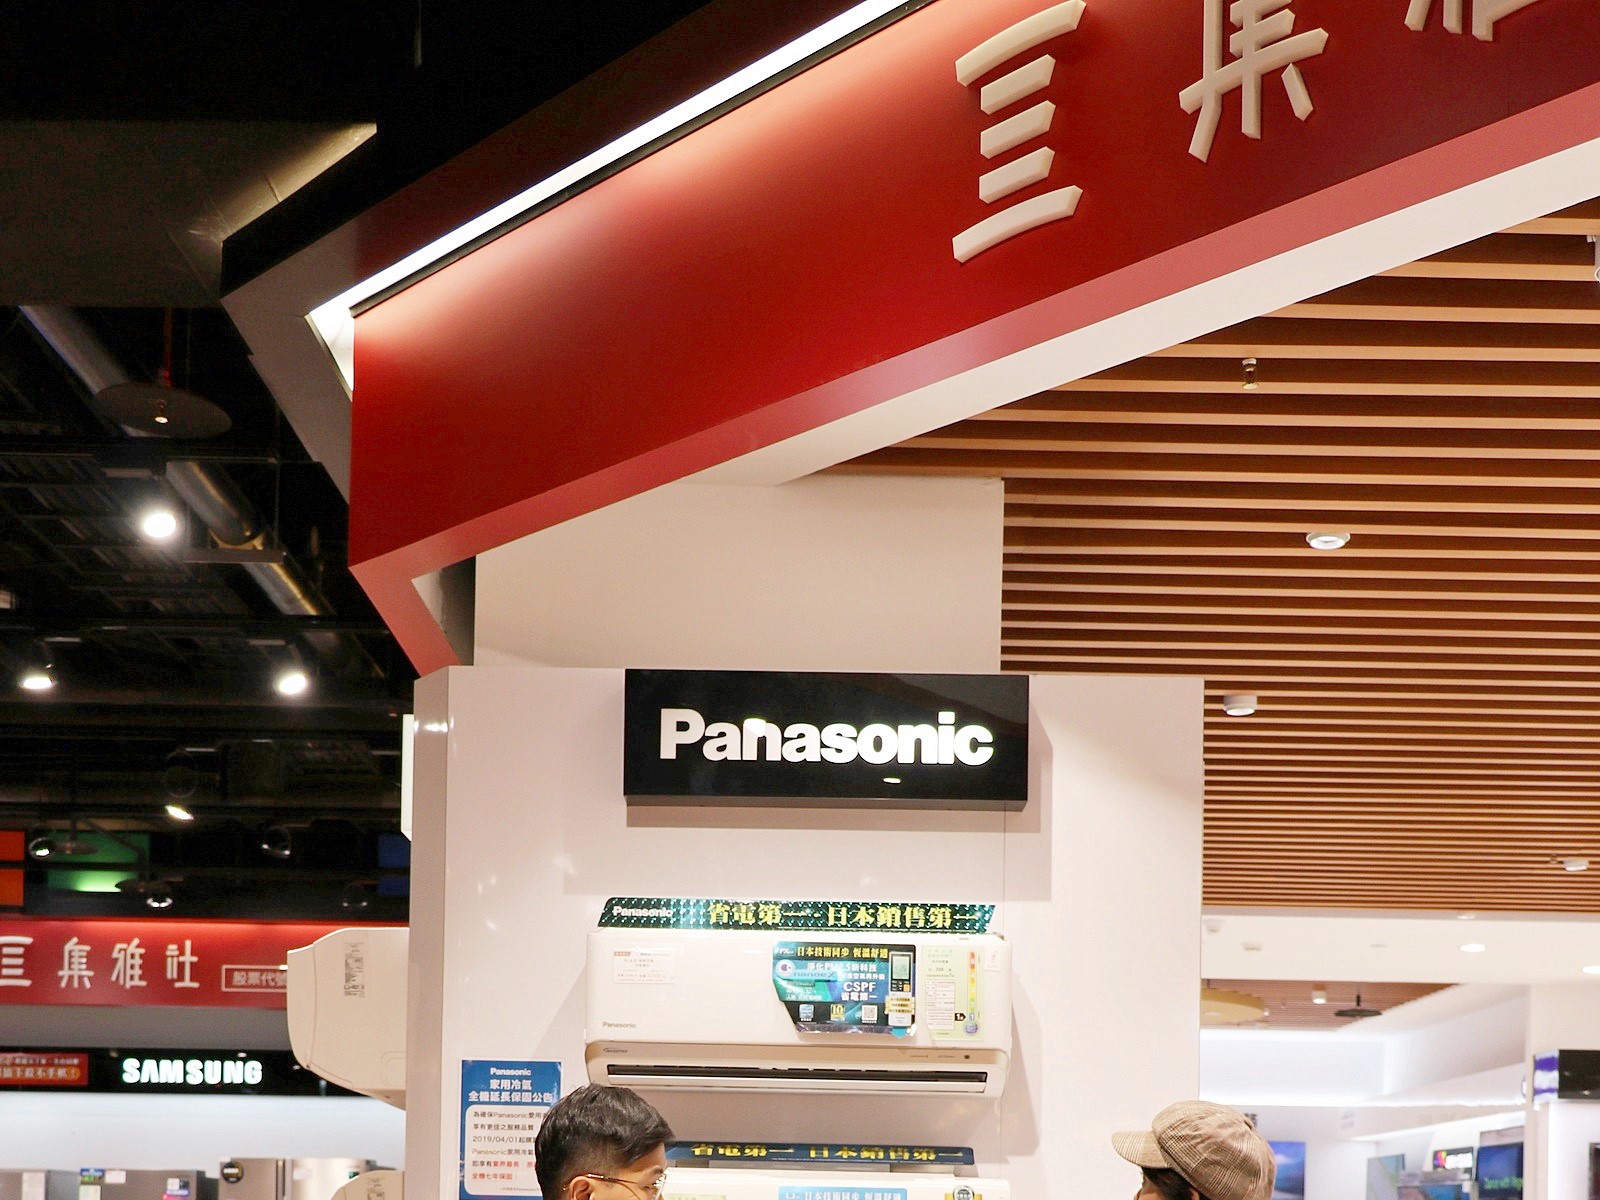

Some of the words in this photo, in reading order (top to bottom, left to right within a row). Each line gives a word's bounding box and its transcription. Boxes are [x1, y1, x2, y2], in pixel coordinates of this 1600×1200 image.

[660, 708, 994, 766] Panasonic
[613, 905, 674, 917] Panasonic
[843, 982, 877, 992] CSPF
[123, 1057, 262, 1085] SAMSUNG
[490, 1068, 532, 1076] Panasonic
[489, 1080, 532, 1091] 家用冷氣
